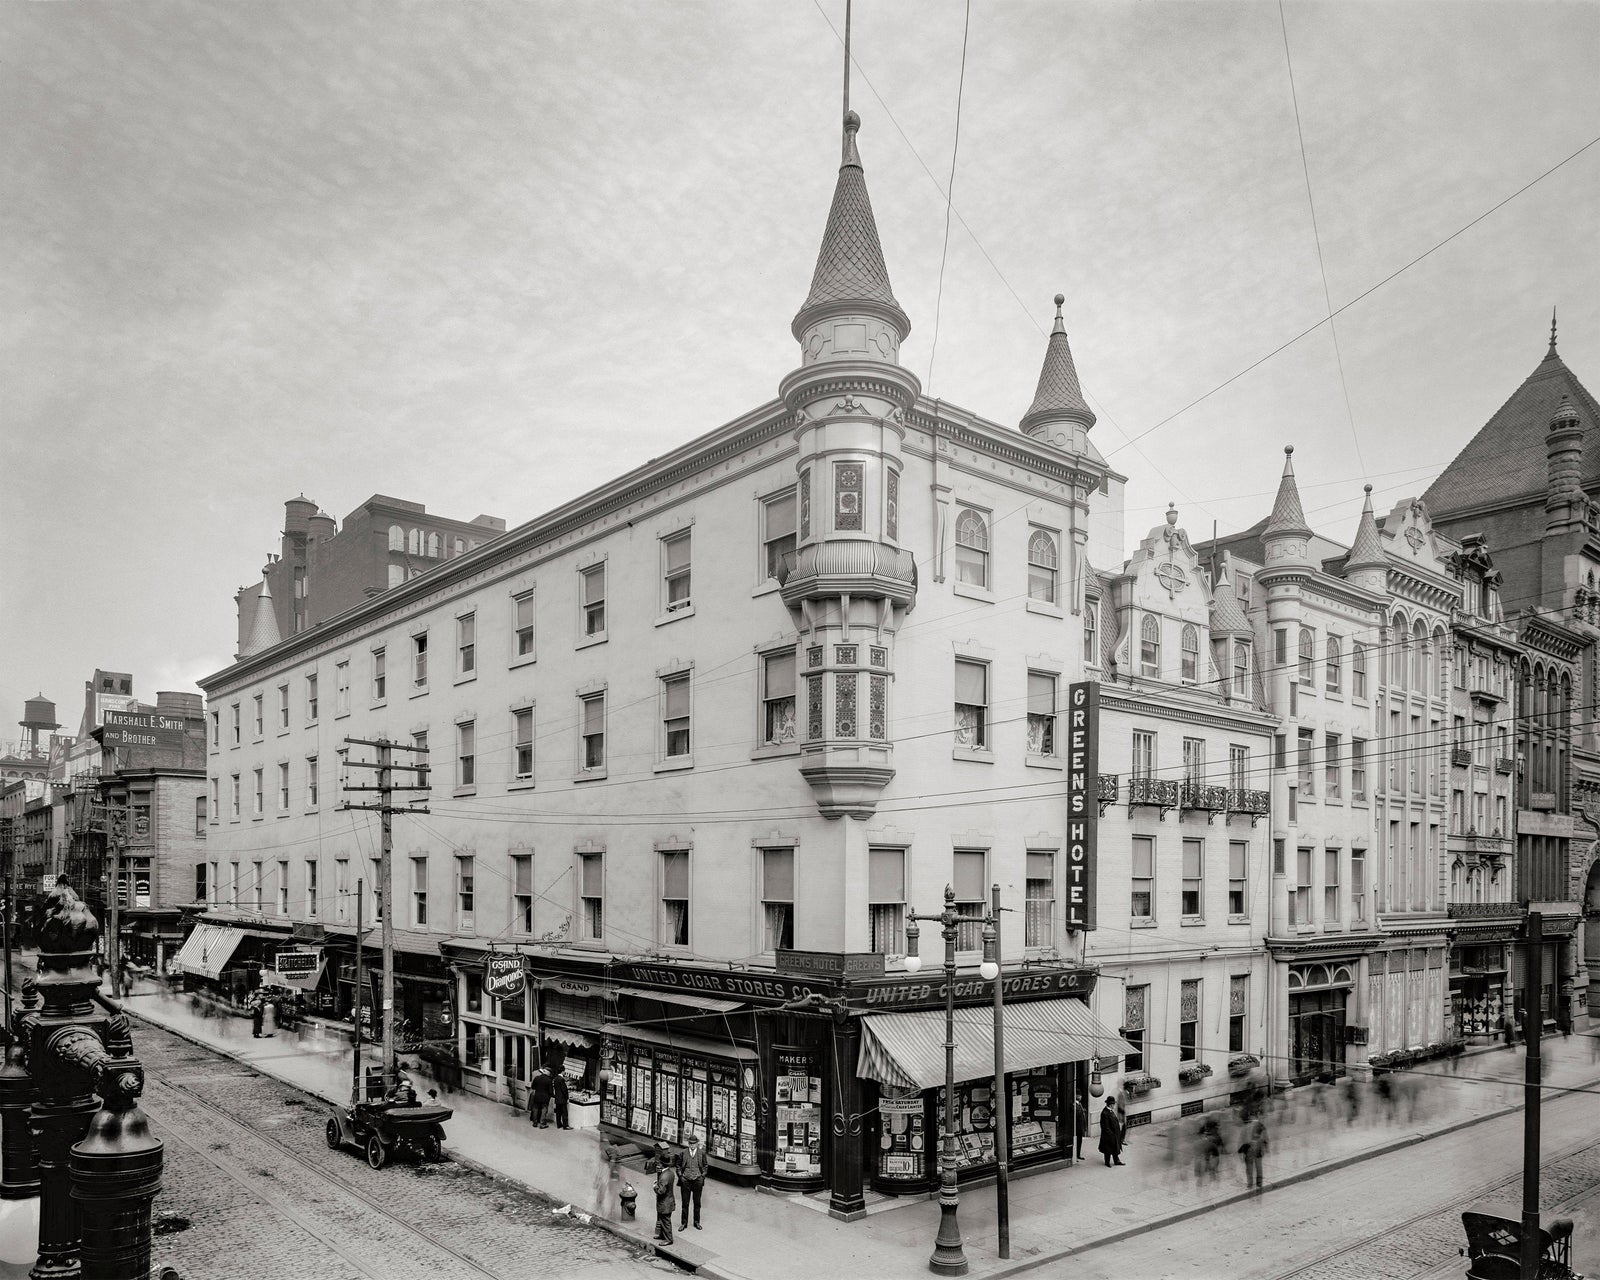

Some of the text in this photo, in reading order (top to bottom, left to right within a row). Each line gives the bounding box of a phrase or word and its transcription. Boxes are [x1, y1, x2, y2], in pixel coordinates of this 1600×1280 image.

[105, 711, 183, 731] MARSHALL E. SMITH
[105, 730, 156, 745] AND BROTHER
[1070, 688, 1086, 923] GREEN'S HOTEL
[491, 960, 520, 973] GSAND
[813, 959, 842, 971] HOTEL
[488, 968, 523, 991] Diamonds
[560, 981, 590, 992] GSAND
[631, 967, 678, 985] UNITED
[682, 974, 722, 990] CIGAR
[726, 978, 785, 998] STORES
[865, 974, 1079, 1004] UNITED CGAR TORES CO.
[779, 1055, 814, 1064] MAKERS
[788, 1077, 808, 1093] UNITED
[780, 1109, 798, 1122] FREE
